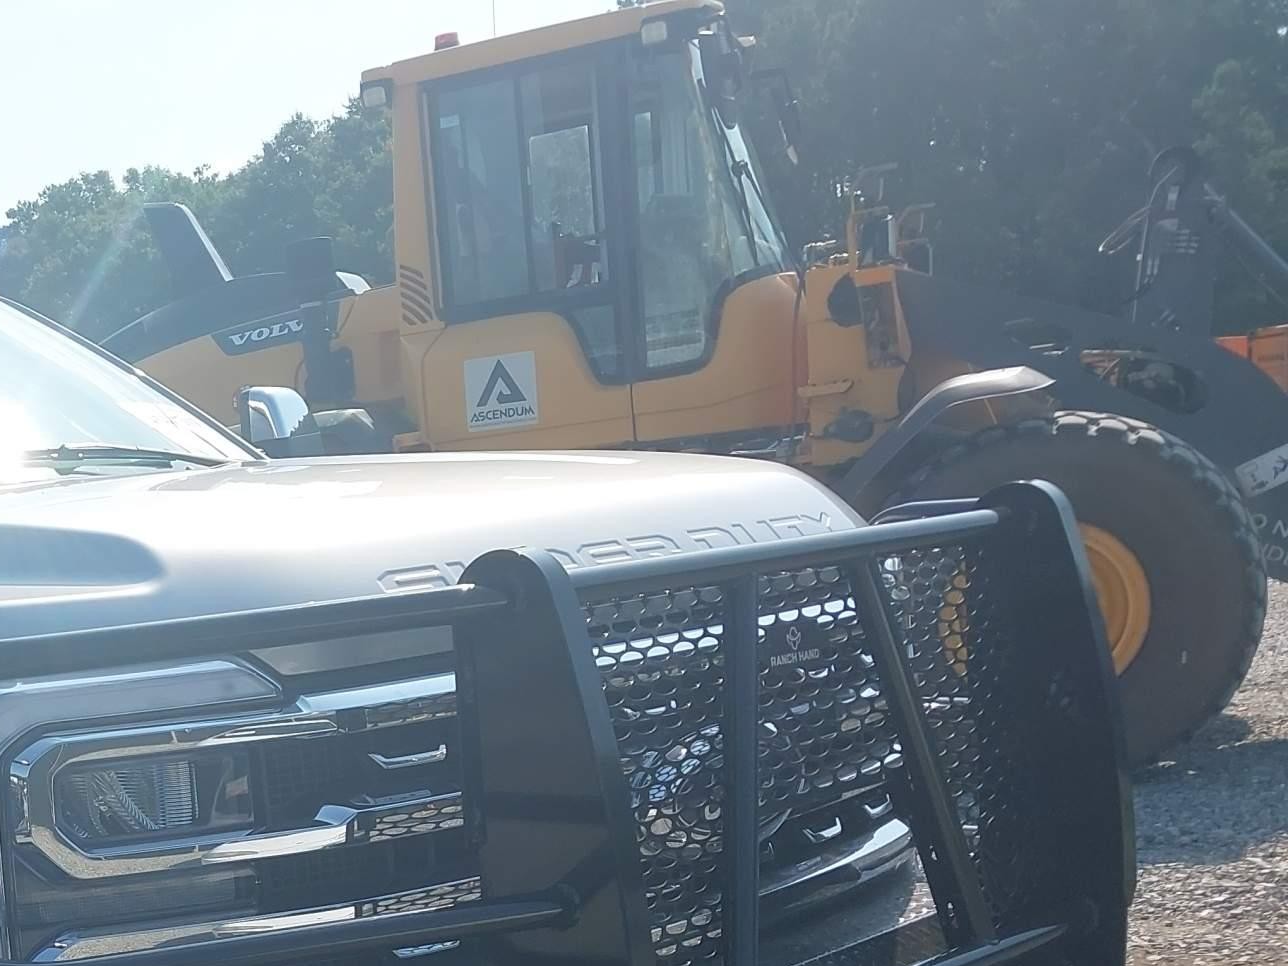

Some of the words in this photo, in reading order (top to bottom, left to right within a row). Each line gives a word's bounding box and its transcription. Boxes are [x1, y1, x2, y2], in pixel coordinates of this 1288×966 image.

[228, 319, 304, 345] VOLV
[470, 406, 535, 423] ASCENDUM
[770, 651, 798, 667] RANCH
[798, 648, 820, 661] HAND
